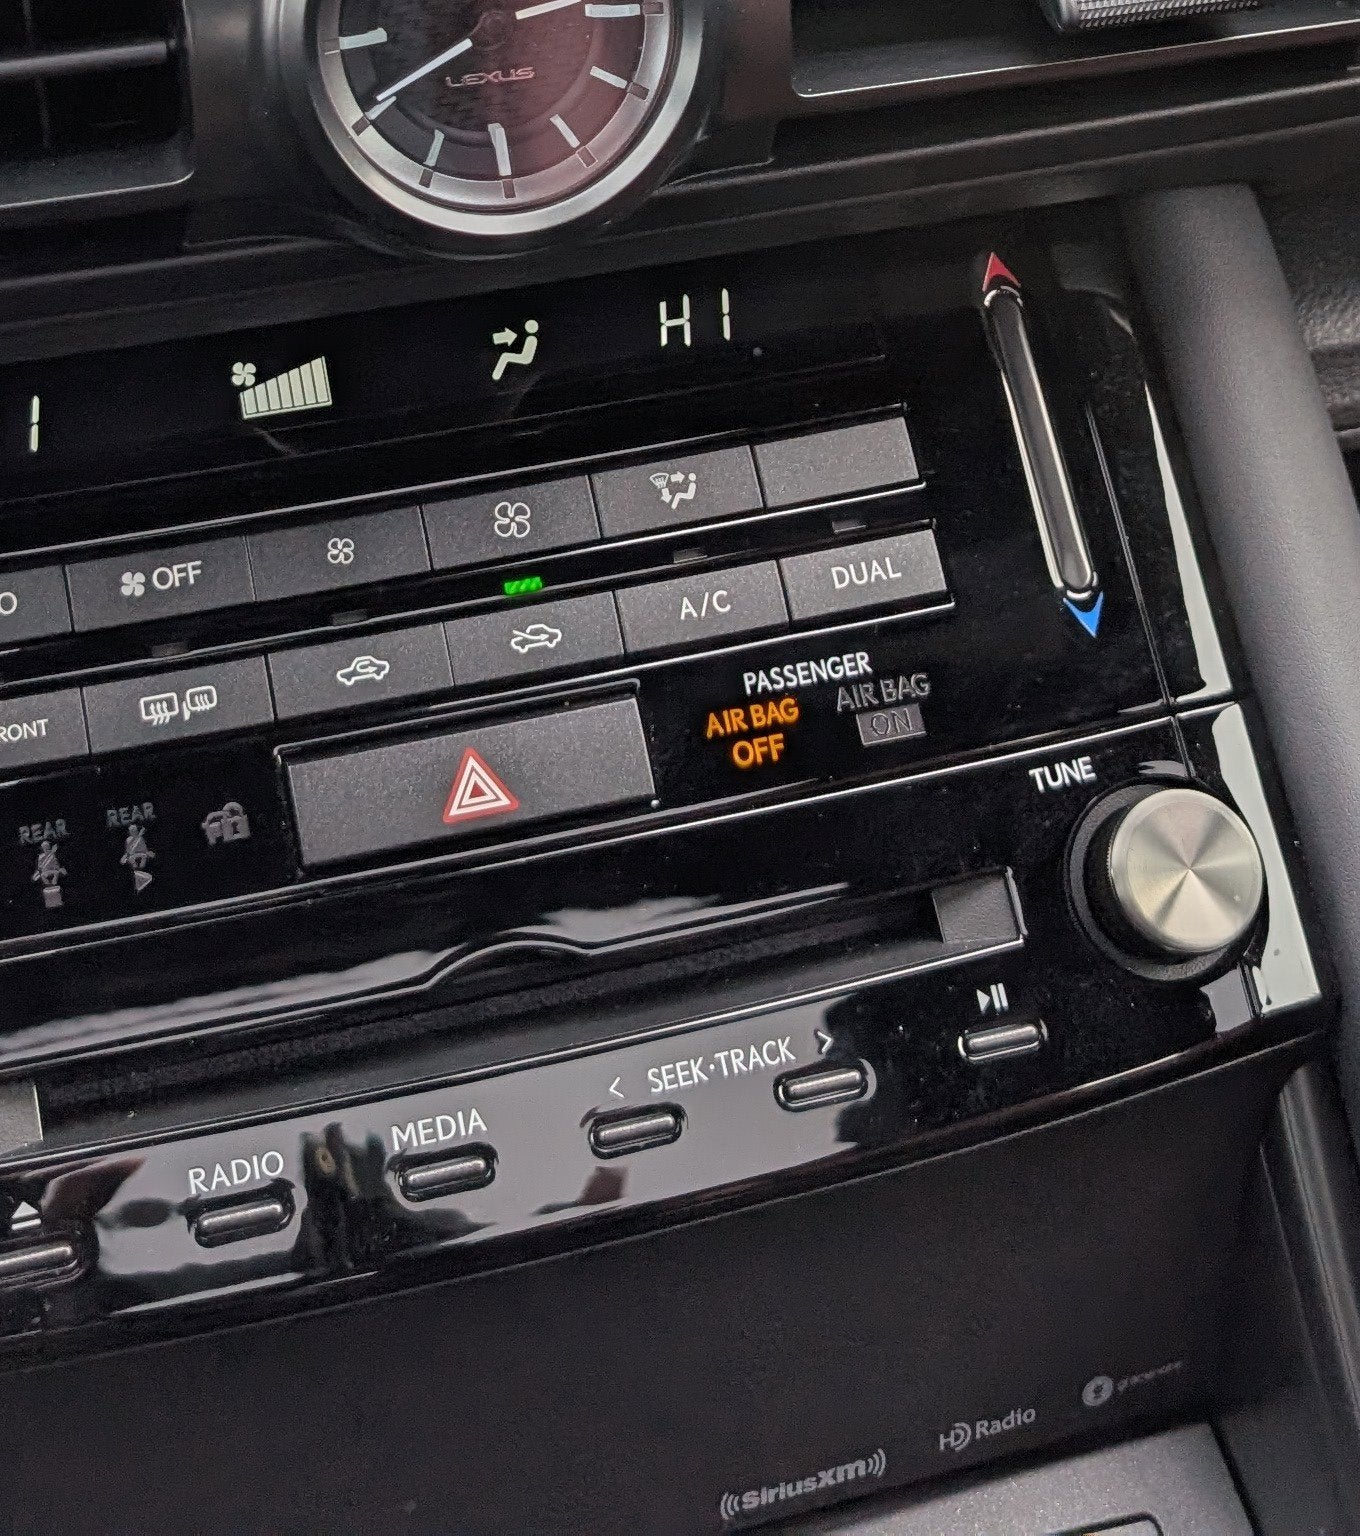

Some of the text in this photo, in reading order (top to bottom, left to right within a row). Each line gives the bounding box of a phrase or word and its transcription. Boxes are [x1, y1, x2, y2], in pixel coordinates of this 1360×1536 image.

[445, 66, 536, 88] LEXUS
[659, 288, 732, 347] HI
[152, 560, 203, 592] OFF
[831, 556, 902, 589] DUAL
[679, 590, 733, 621] A/C
[742, 651, 873, 697] PASSENGER
[836, 672, 931, 713] AIR BAG
[705, 696, 800, 739] AIR BAG
[870, 707, 915, 737] ON
[731, 732, 785, 768] OFF
[1028, 756, 1097, 793] TUNE
[18, 817, 70, 845] REAR
[105, 801, 157, 828] REAR
[390, 1106, 489, 1152] MEDIA
[187, 1150, 286, 1194] RADIO
[975, 1407, 1037, 1440] Radio
